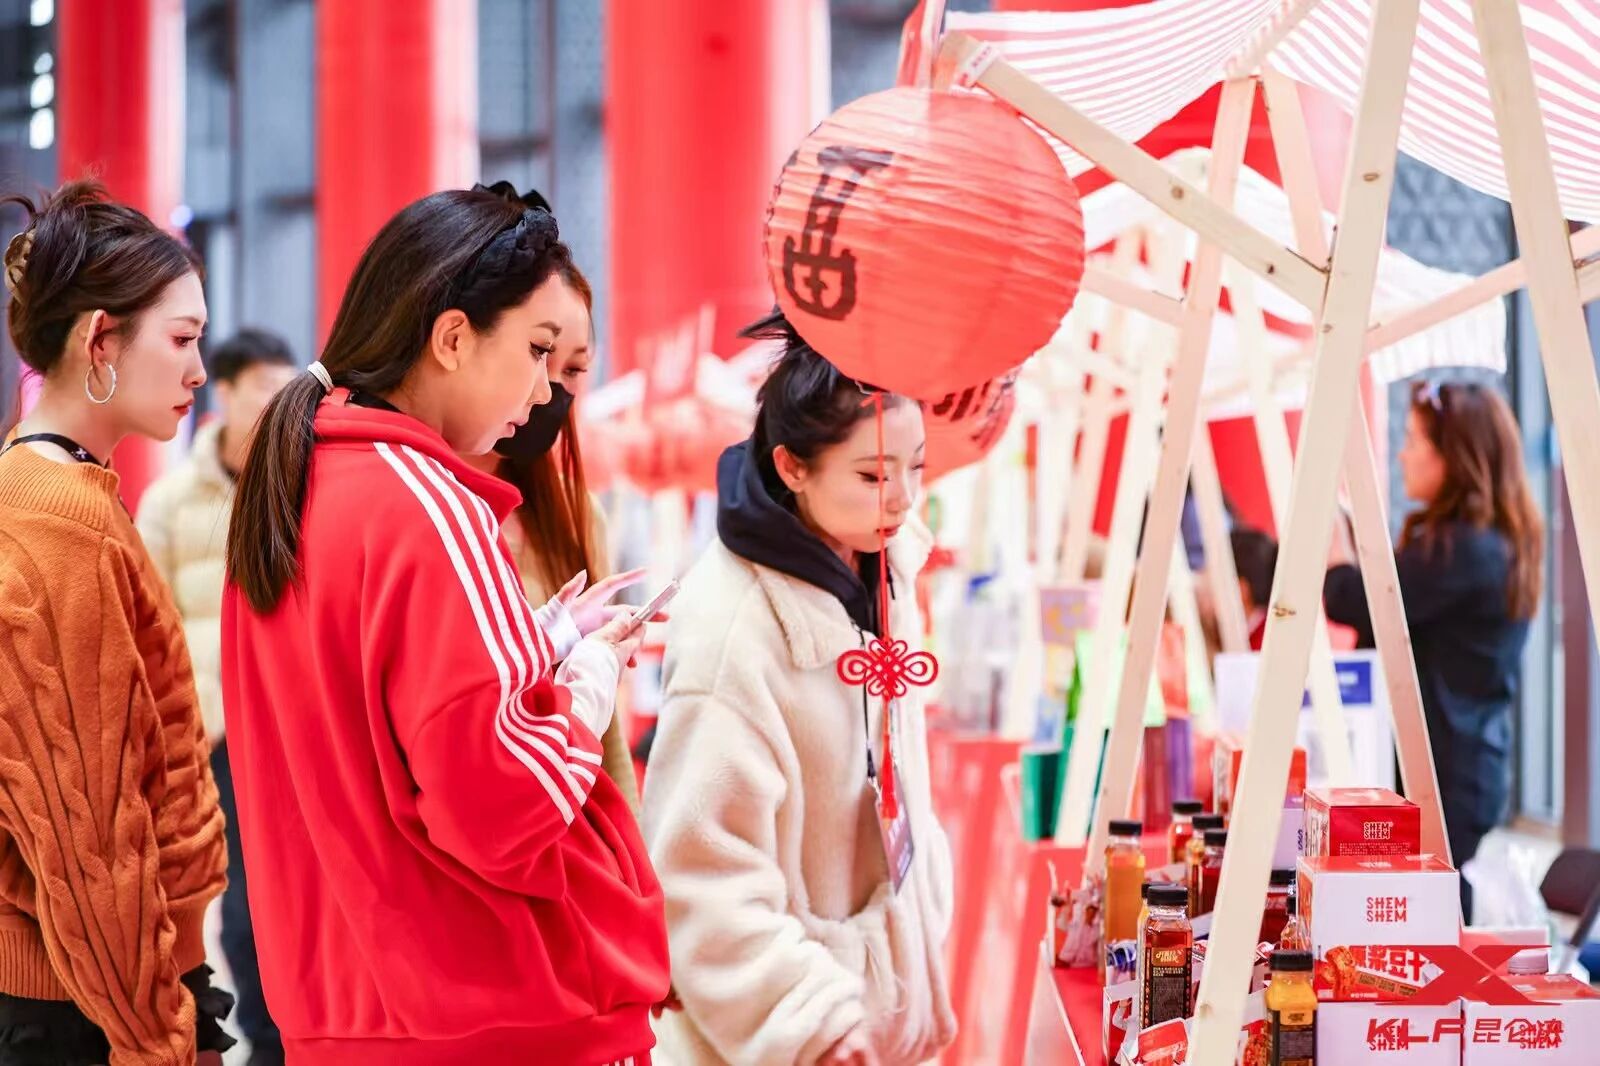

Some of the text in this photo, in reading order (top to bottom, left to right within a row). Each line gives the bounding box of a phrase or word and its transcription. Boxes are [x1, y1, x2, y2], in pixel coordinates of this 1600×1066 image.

[1364, 822, 1390, 831] SHEM
[1364, 831, 1390, 839] SHEM
[1366, 897, 1407, 909] SHEM
[1366, 910, 1407, 922] SHEM
[1369, 1039, 1409, 1051] SHEM
[1519, 1037, 1559, 1049] SHEM
